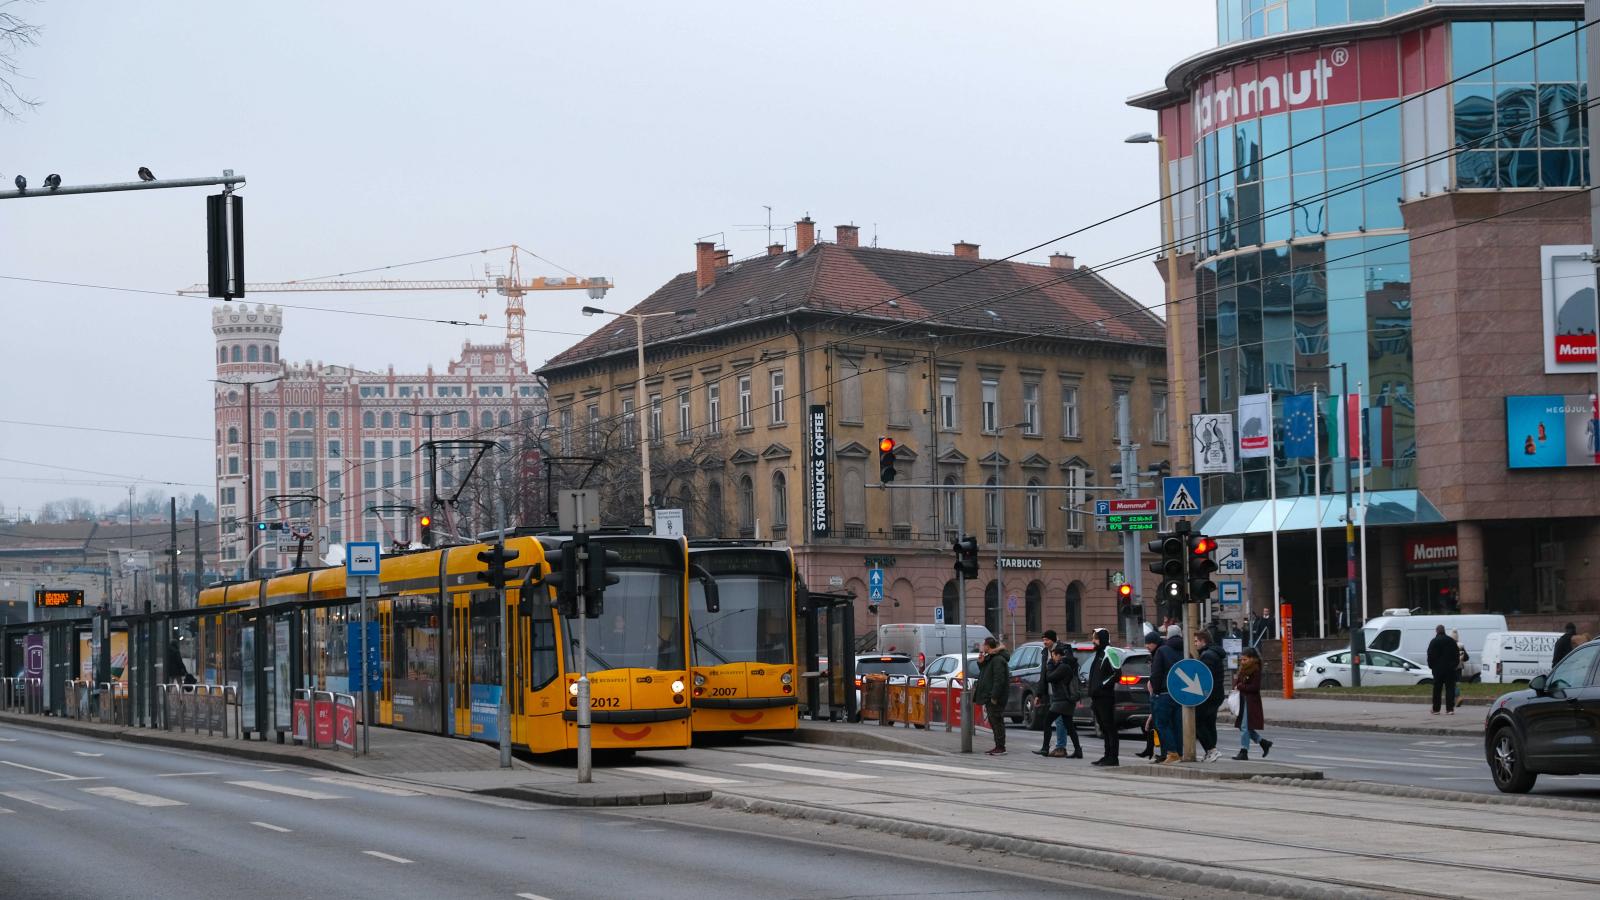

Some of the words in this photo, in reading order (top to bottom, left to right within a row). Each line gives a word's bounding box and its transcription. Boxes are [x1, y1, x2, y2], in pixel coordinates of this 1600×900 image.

[814, 412, 825, 456] COFFEE
[815, 460, 826, 530] STARBUCKS
[591, 697, 620, 708] 2012
[712, 687, 738, 697] 2007
